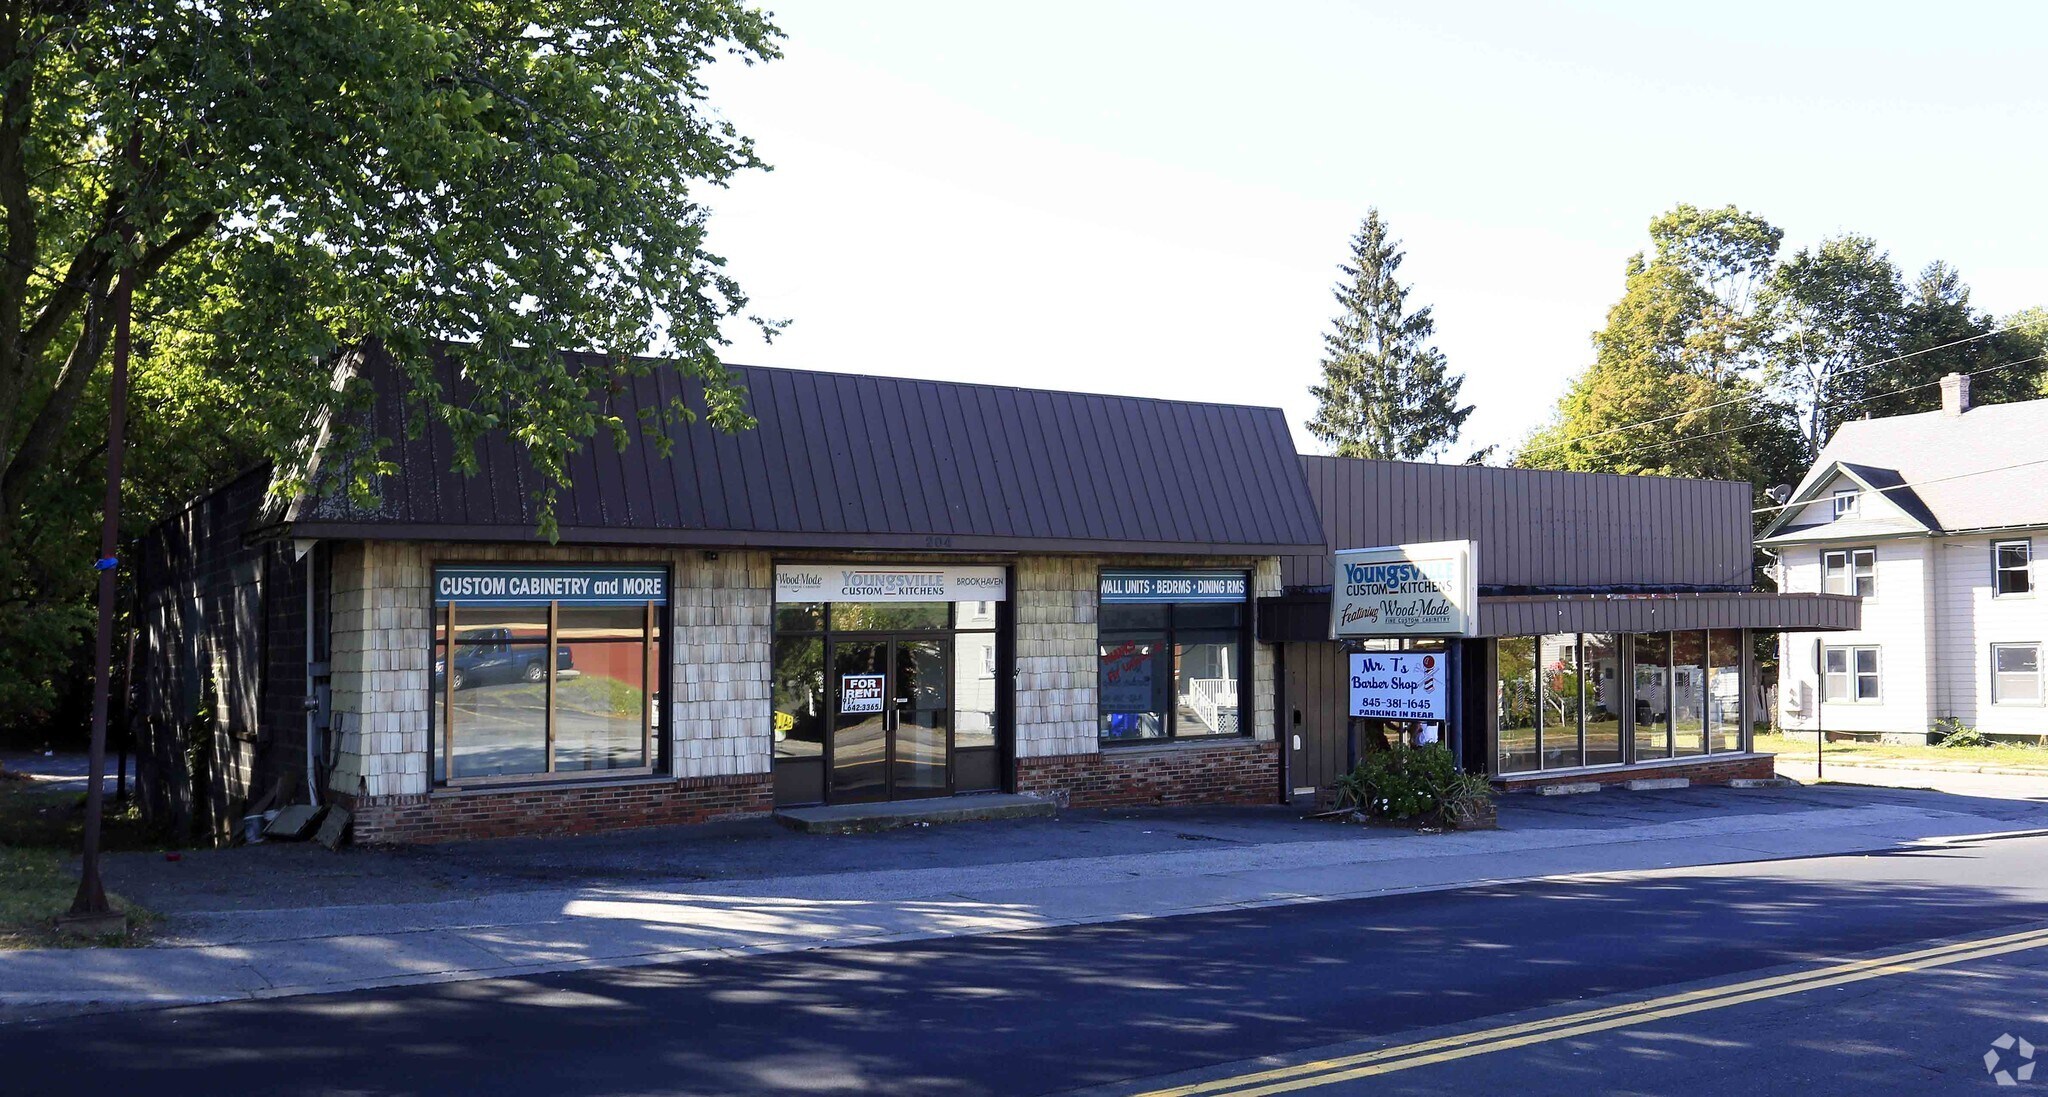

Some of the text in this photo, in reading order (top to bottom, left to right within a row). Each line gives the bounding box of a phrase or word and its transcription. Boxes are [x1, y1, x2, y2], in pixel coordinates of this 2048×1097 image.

[925, 536, 952, 547] 204
[776, 573, 822, 585] Wood-Mode
[956, 577, 1004, 588] BROOKHAVEN
[439, 577, 662, 595] CUSTOM CABINETRY and MORE
[841, 586, 944, 596] CUSTOM KITCHENS
[1101, 579, 1245, 594] WALL UNITS BEDRMS DINING RMS
[1346, 580, 1453, 597] CUSTOM KITCHENS
[1380, 598, 1450, 617] Wood-Mode
[1361, 658, 1385, 674] Mr.
[850, 679, 876, 688] FOR
[1351, 676, 1419, 694] Barber Shop
[846, 688, 880, 698] RENT
[1362, 698, 1431, 709] 845-381-1645
[1359, 709, 1397, 717] PARKING
[1410, 710, 1434, 719] REAR
